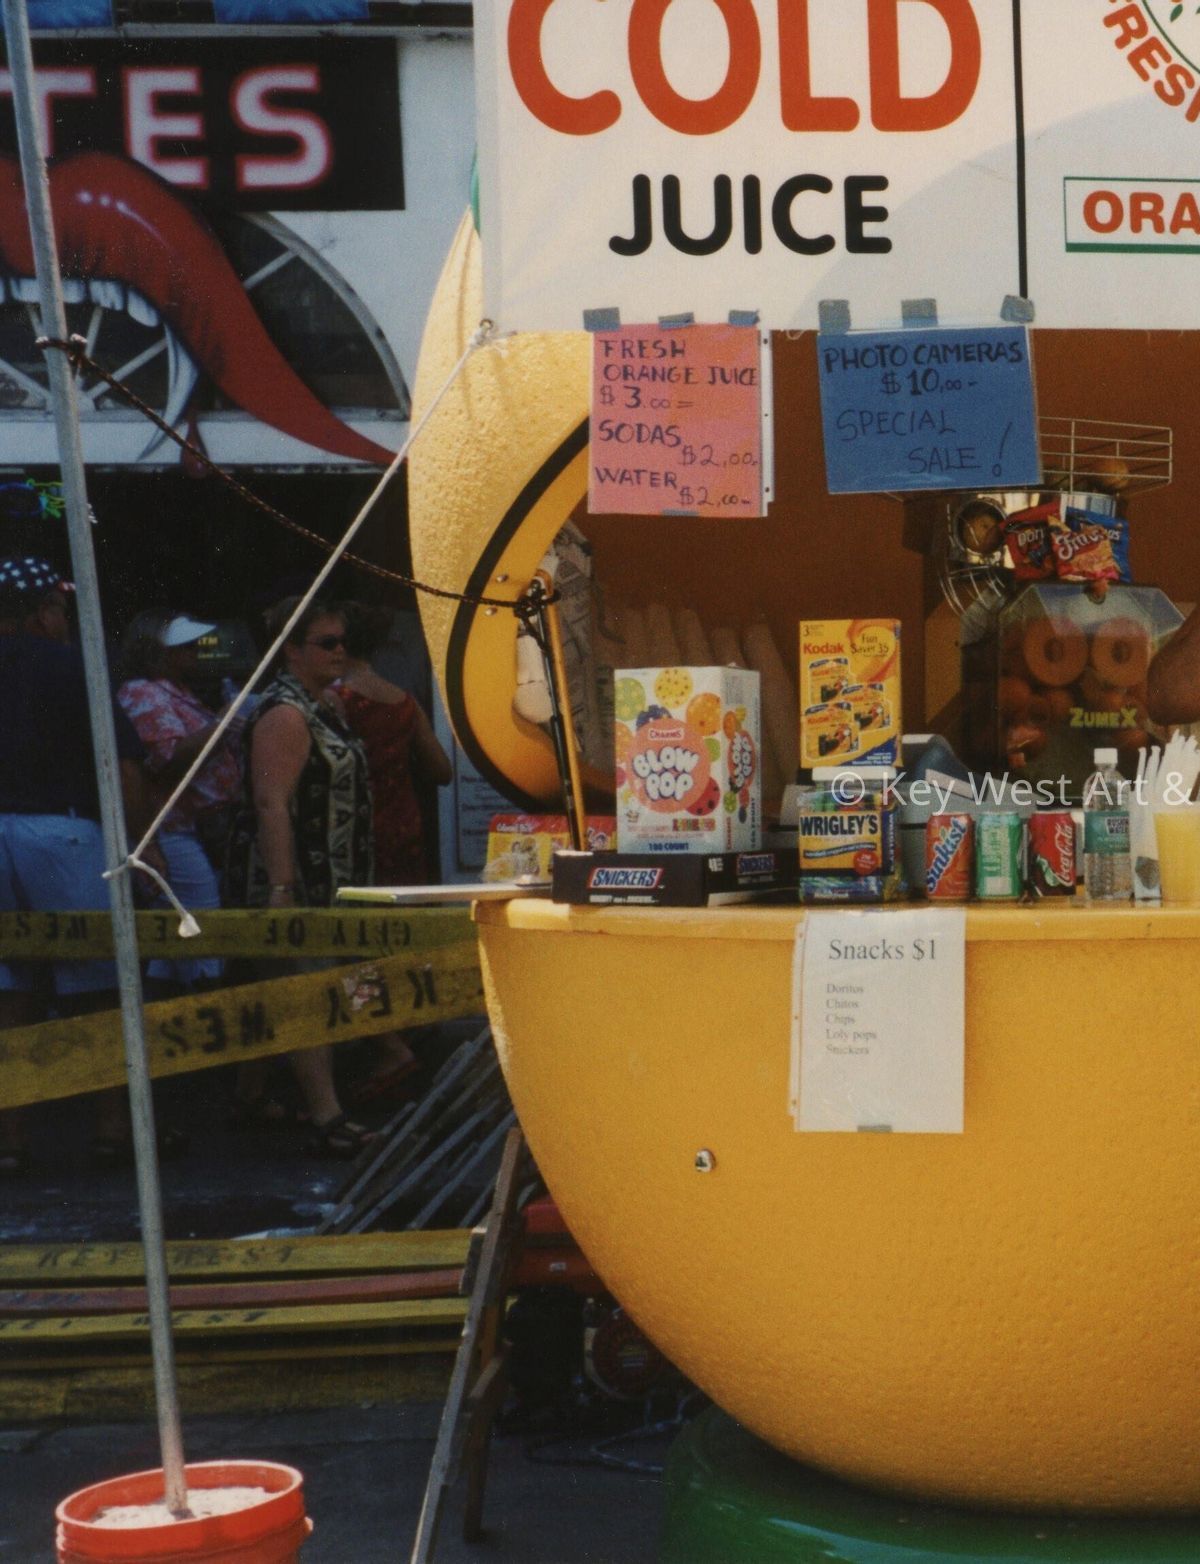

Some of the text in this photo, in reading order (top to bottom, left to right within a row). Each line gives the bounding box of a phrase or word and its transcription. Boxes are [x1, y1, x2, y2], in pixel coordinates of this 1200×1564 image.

[507, 0, 981, 136] COLD
[608, 173, 893, 257] JUICE
[600, 339, 687, 359] FRESH
[823, 341, 1023, 374] PHOTO CAMERAS
[603, 364, 758, 386] ORANGE JUICE
[599, 419, 682, 448] SODAS
[836, 408, 957, 441] SPECIAL
[907, 446, 982, 475] SALE
[594, 465, 678, 490] WATER
[803, 642, 844, 655] Kodak
[1069, 706, 1138, 729] ZUMEX
[632, 745, 700, 779] BLOW
[645, 771, 694, 801] POP
[800, 814, 878, 836] WRIGLEY'S
[926, 815, 968, 893] Sunkist
[592, 868, 658, 887] SNICKERS
[828, 939, 937, 961] Snacks $1
[825, 983, 865, 995] Doritos
[158, 1000, 276, 1058] WES
[825, 1014, 856, 1027] Chips
[852, 1031, 878, 1042] pops
